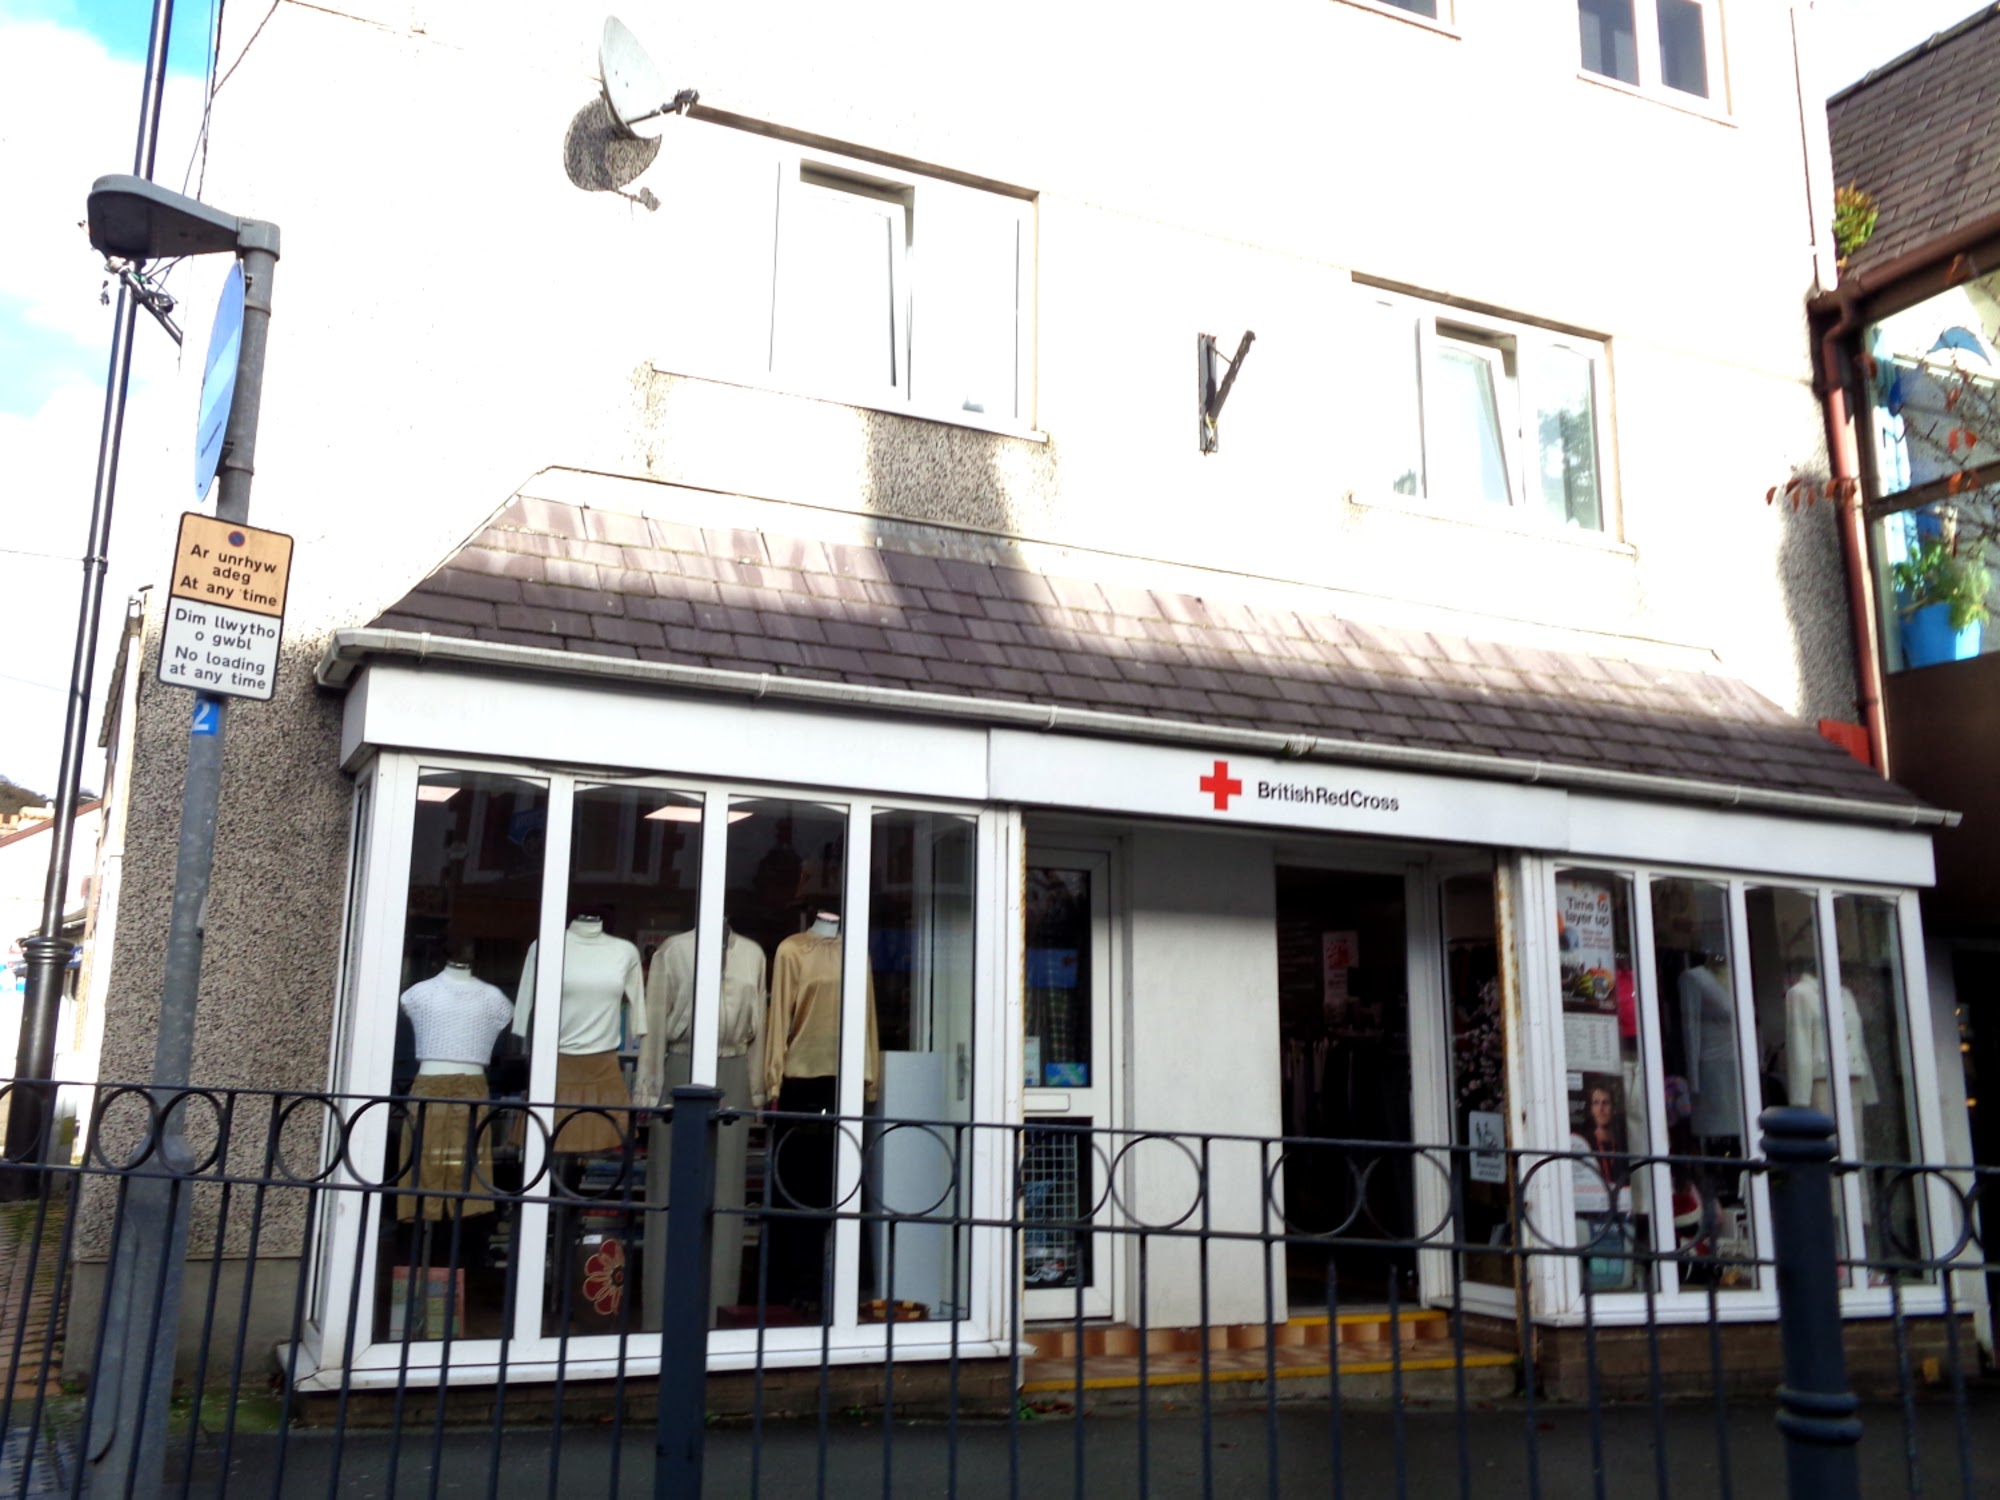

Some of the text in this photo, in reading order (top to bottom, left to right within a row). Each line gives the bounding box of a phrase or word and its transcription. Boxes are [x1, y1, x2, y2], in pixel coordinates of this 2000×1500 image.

[189, 543, 278, 574] Ar unrhyw
[212, 566, 252, 585] adeg
[180, 575, 278, 607] At any time
[175, 608, 276, 639] Dim llwytho
[194, 631, 252, 651] o gwbl
[175, 645, 266, 676] No loading
[169, 663, 267, 690] at any time
[192, 702, 210, 731] 2
